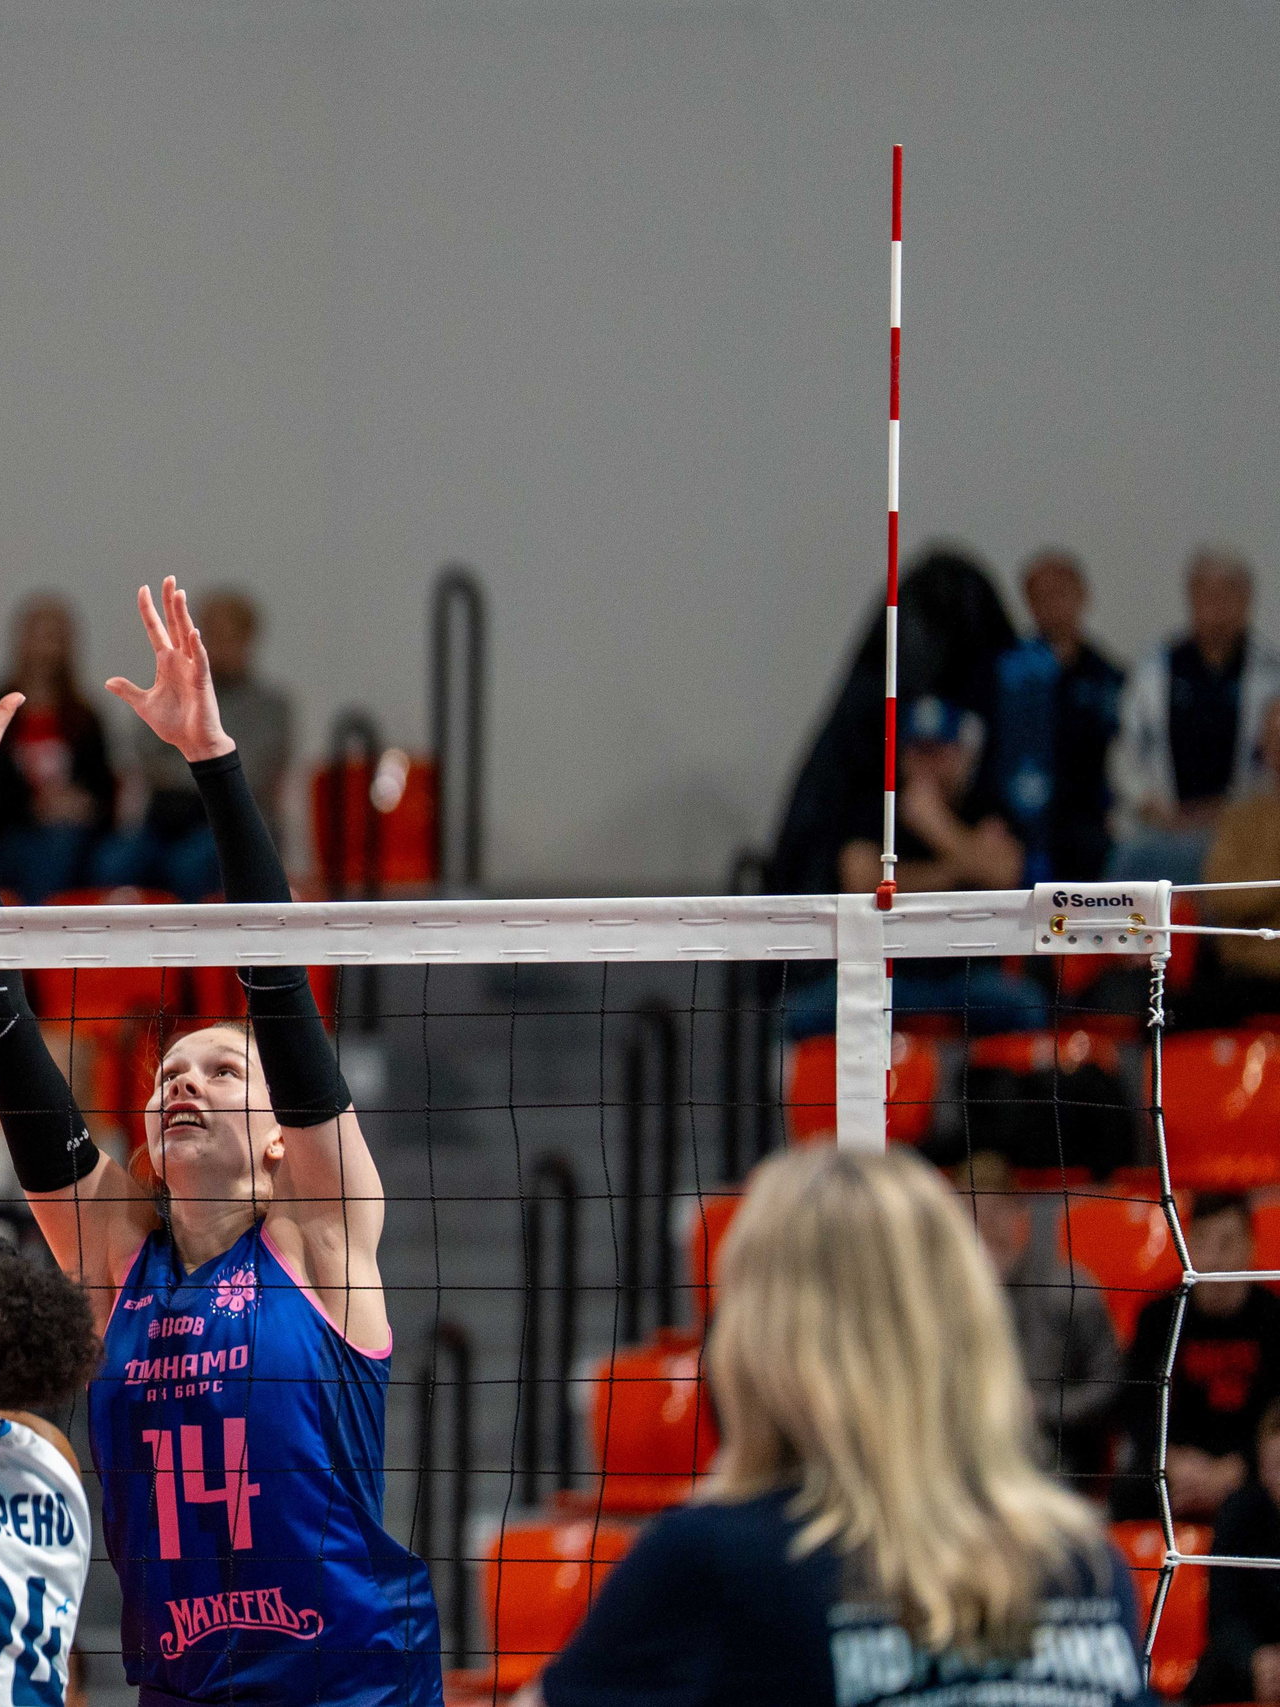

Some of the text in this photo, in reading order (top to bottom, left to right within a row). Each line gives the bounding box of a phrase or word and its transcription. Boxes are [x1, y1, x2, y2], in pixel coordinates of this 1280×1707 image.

[1070, 894, 1134, 907] Senoh
[161, 1315, 205, 1338] ВФВ
[124, 1344, 249, 1385] ДИНАМО
[175, 1380, 224, 1398] БАРС
[142, 1417, 261, 1560] 14
